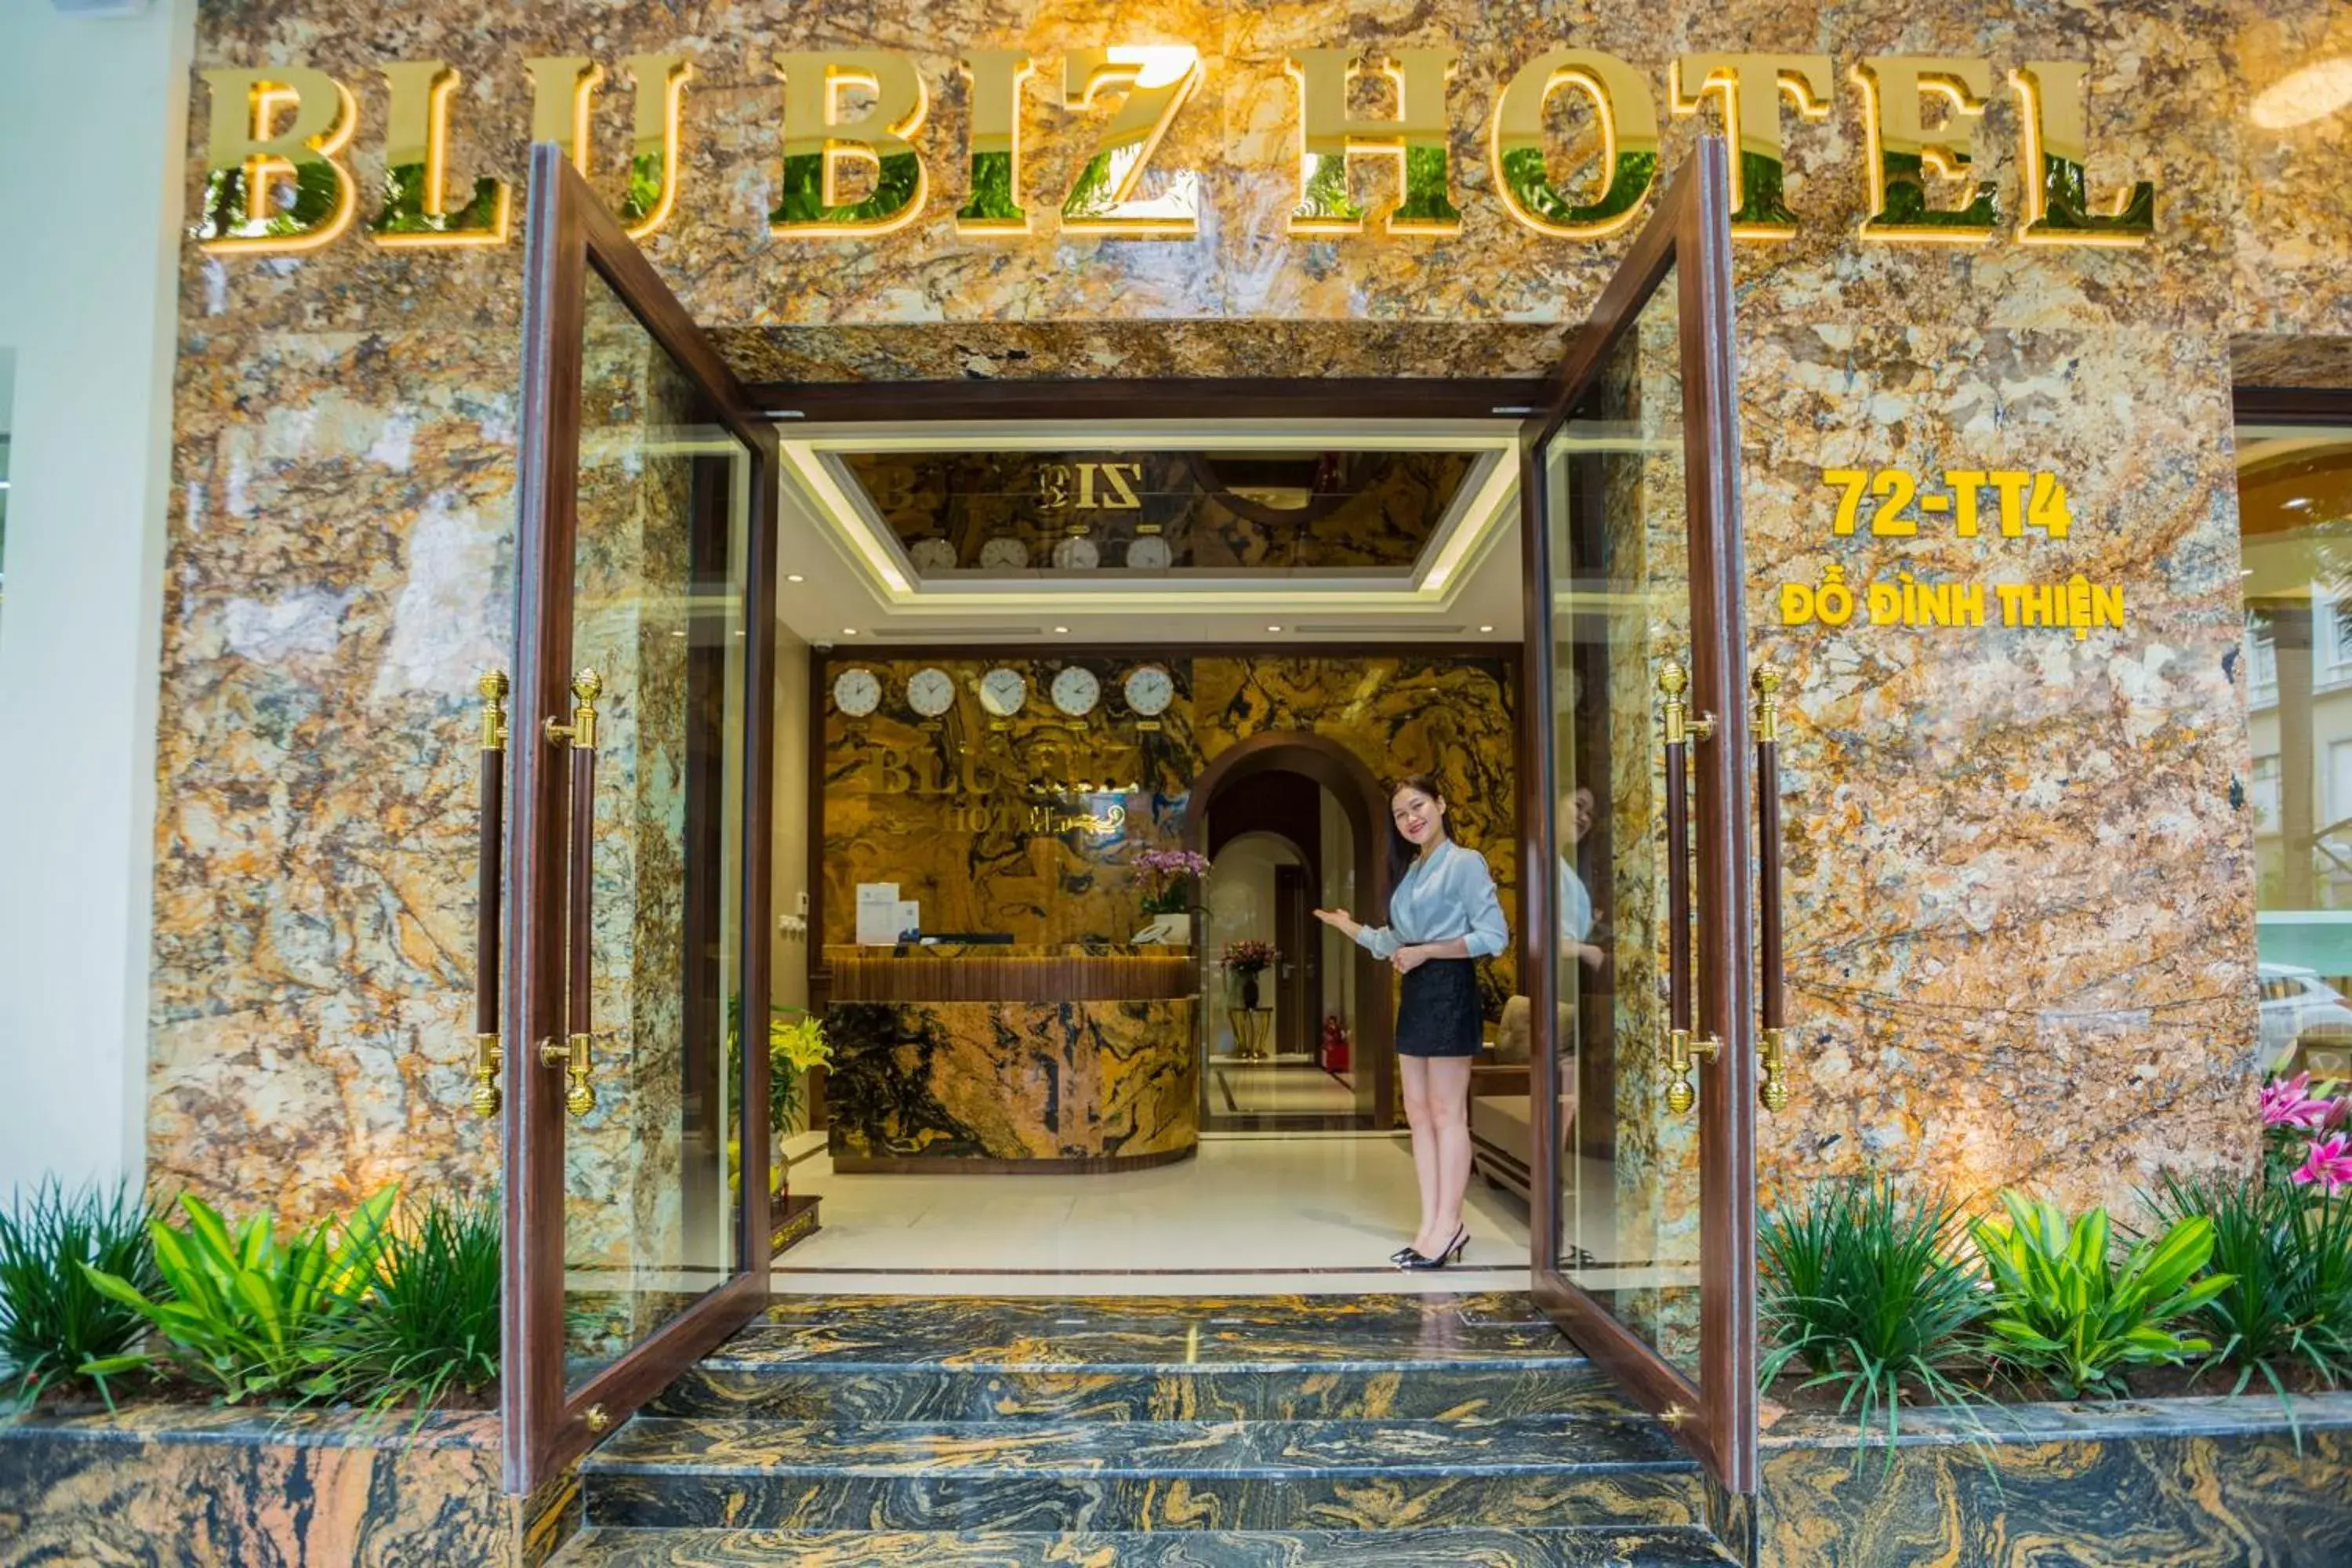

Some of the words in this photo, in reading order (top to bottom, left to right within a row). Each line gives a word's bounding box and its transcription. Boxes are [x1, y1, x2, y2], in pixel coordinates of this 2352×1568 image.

[192, 55, 693, 252] BLU
[771, 46, 1205, 238] BIZ
[1285, 48, 2154, 247] HOTEL
[1822, 469, 2073, 539] 72-TT4
[1780, 564, 1854, 626] ĐỖ
[1867, 571, 1984, 626] ĐÌNH
[1995, 573, 2125, 641] THIỆN
